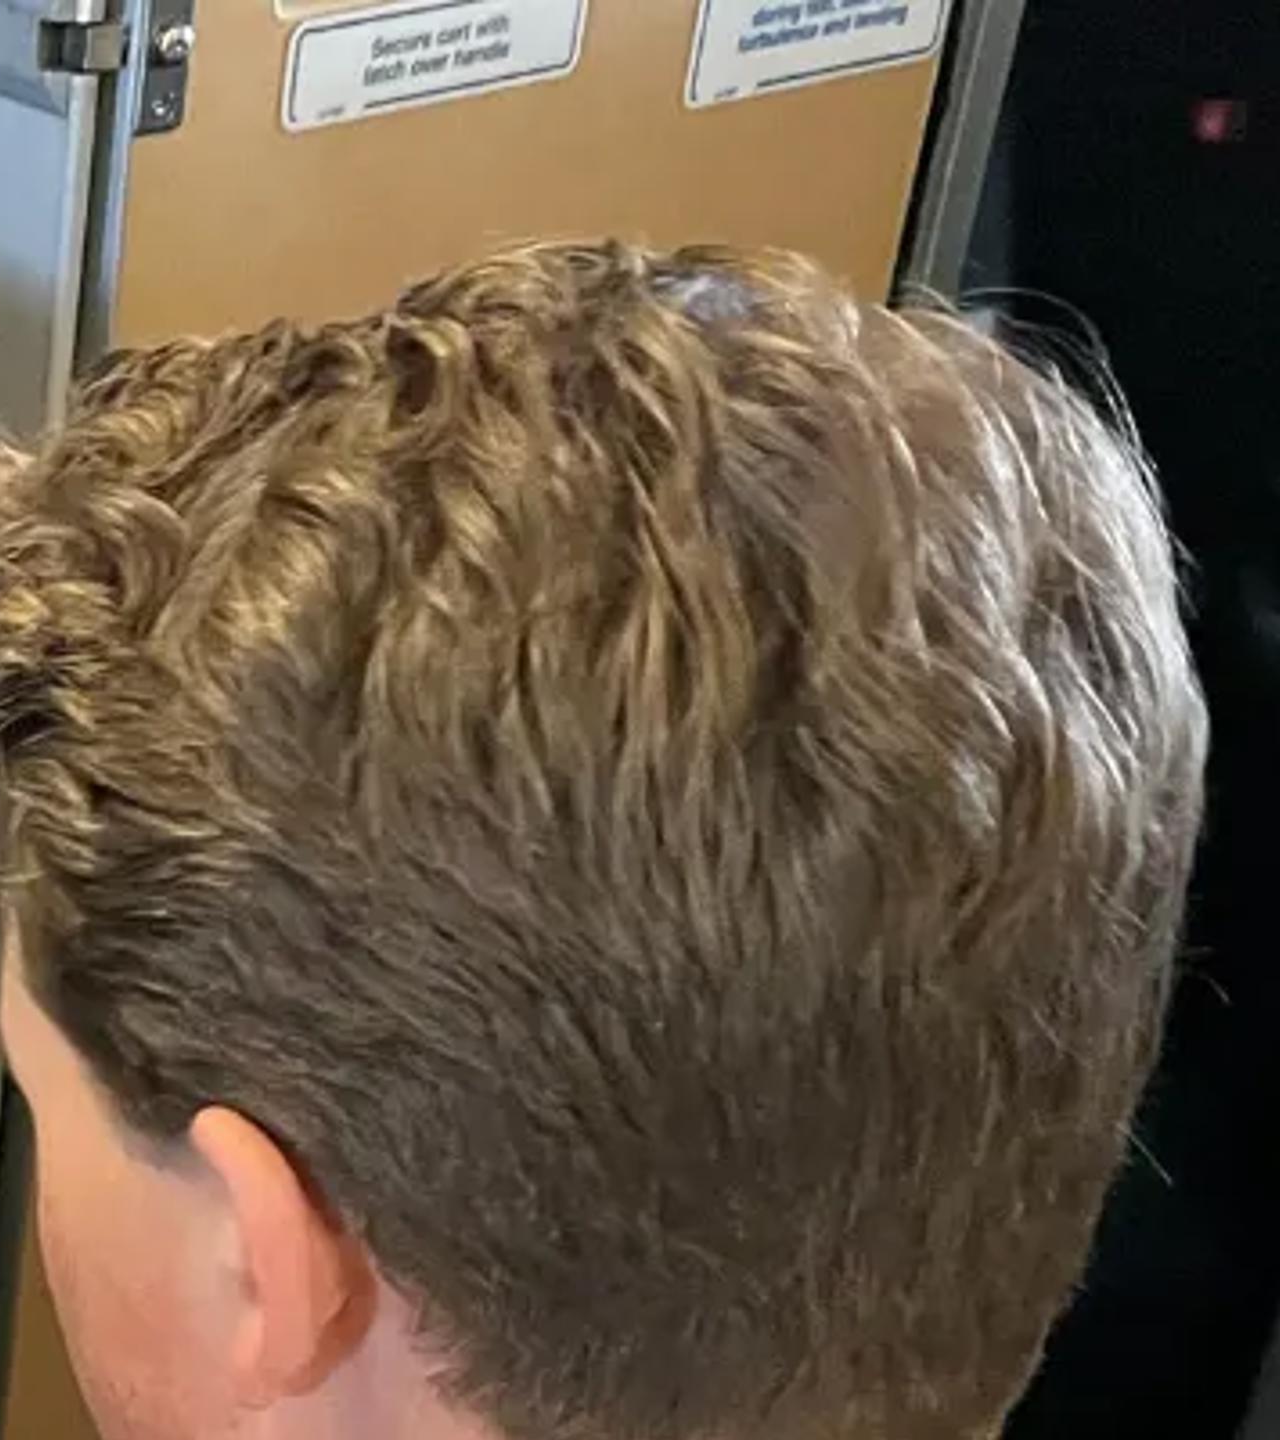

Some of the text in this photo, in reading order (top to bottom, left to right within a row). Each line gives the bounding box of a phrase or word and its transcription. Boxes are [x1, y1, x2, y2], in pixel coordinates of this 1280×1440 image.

[370, 14, 511, 58] Secure cart with
[738, 24, 819, 51] turbulence
[822, 15, 851, 36] and
[363, 41, 511, 87] latch over handle
